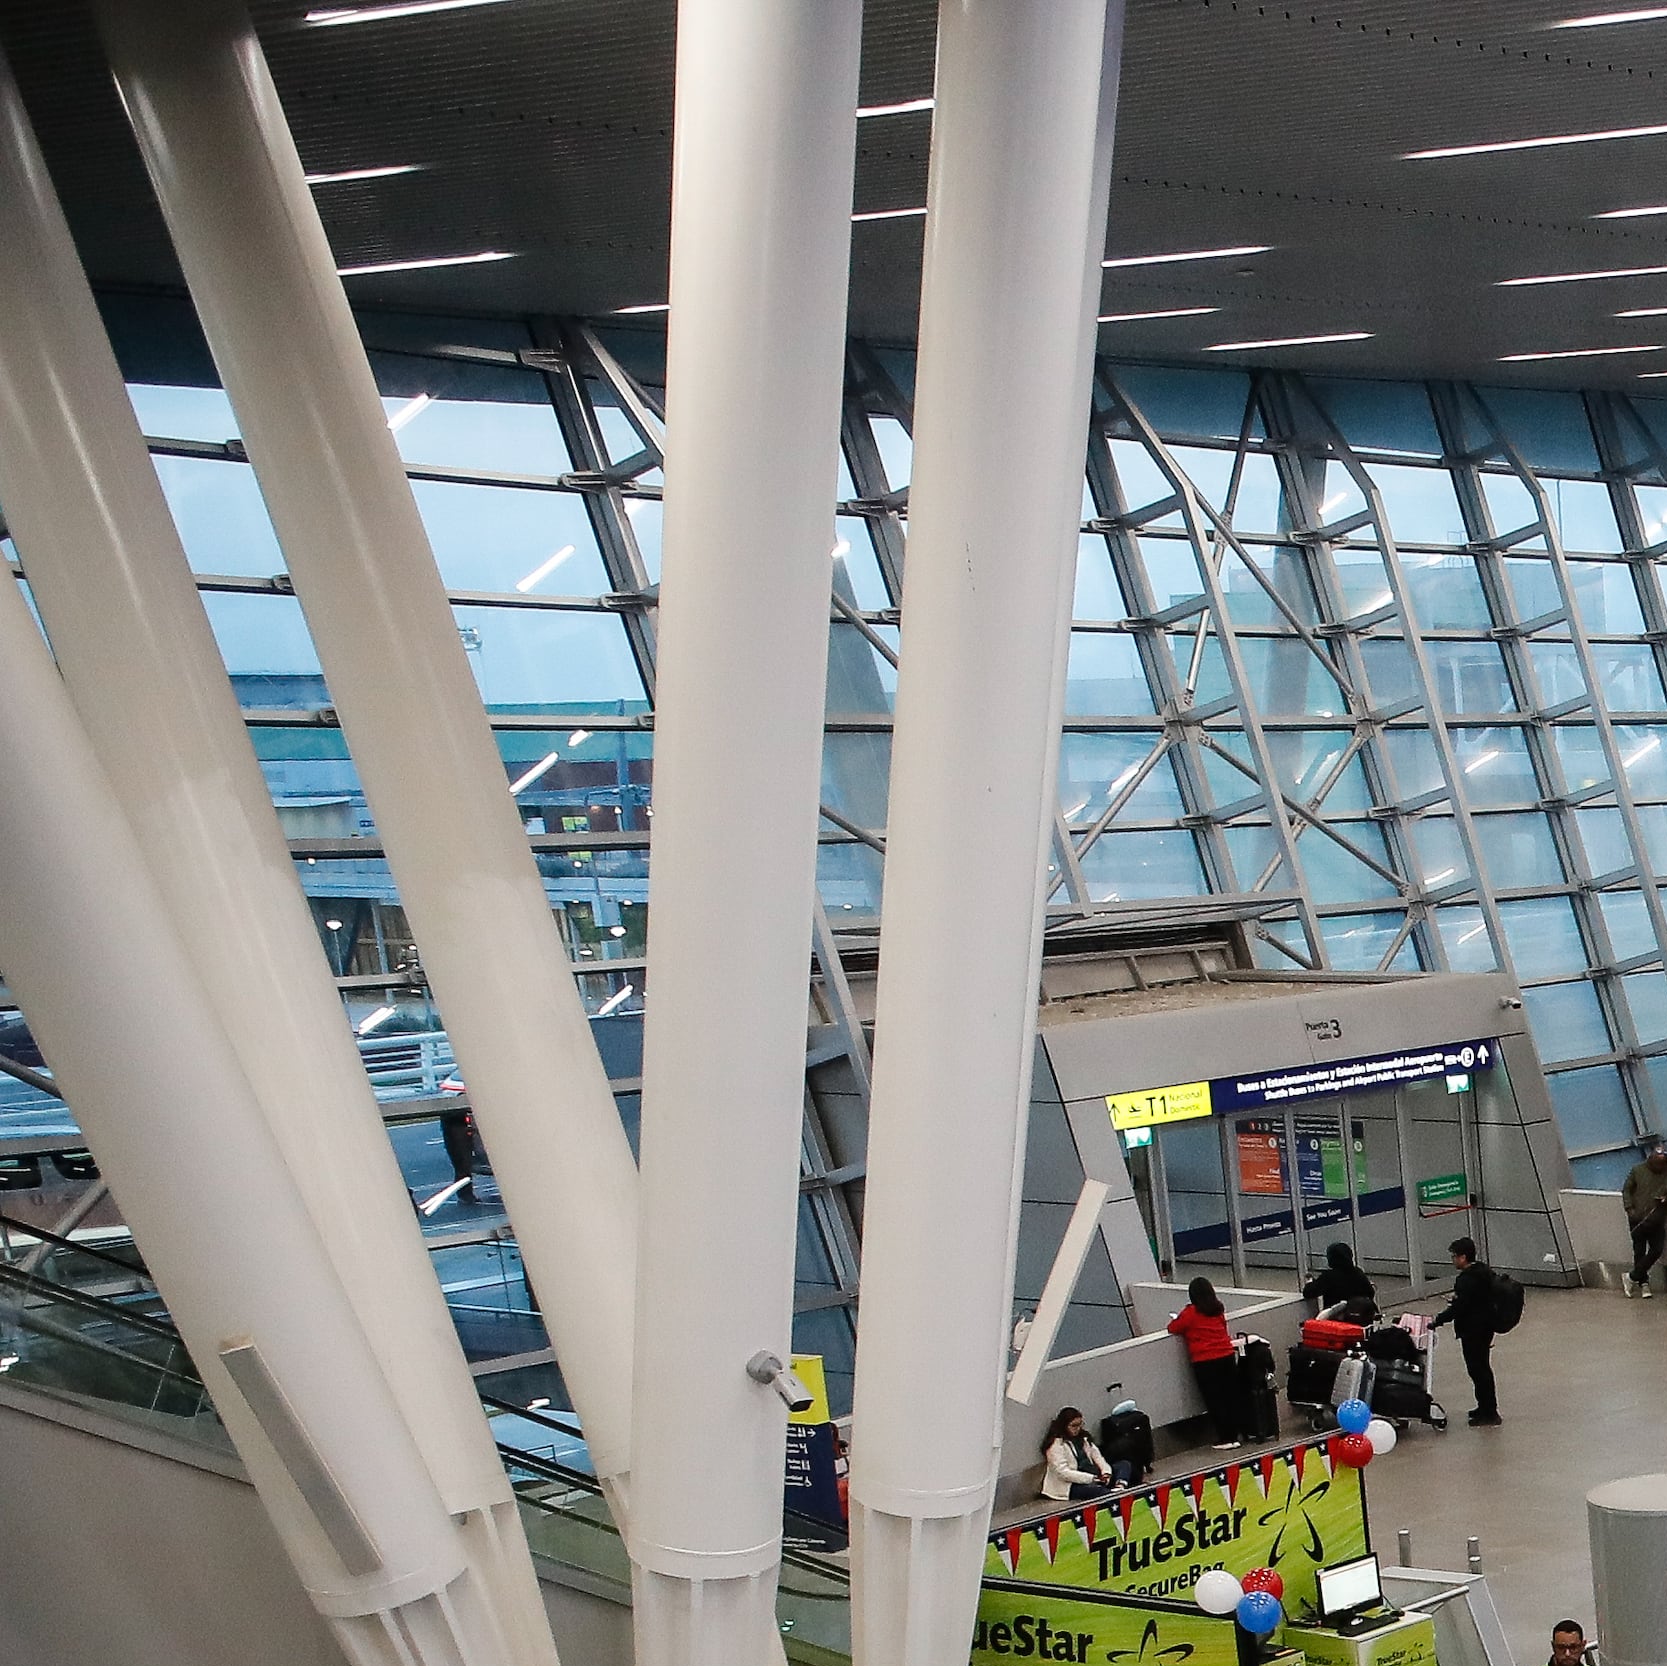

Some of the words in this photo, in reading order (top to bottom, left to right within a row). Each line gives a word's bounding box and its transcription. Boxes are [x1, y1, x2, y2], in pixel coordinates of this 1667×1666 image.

[1305, 1021, 1329, 1032] Puerta
[1330, 1019, 1342, 1039] 3
[1145, 1095, 1168, 1117] T1
[1089, 1507, 1248, 1582] TrueStar
[971, 1614, 1093, 1664] ueStar
[1376, 1649, 1407, 1666] TrueStar
